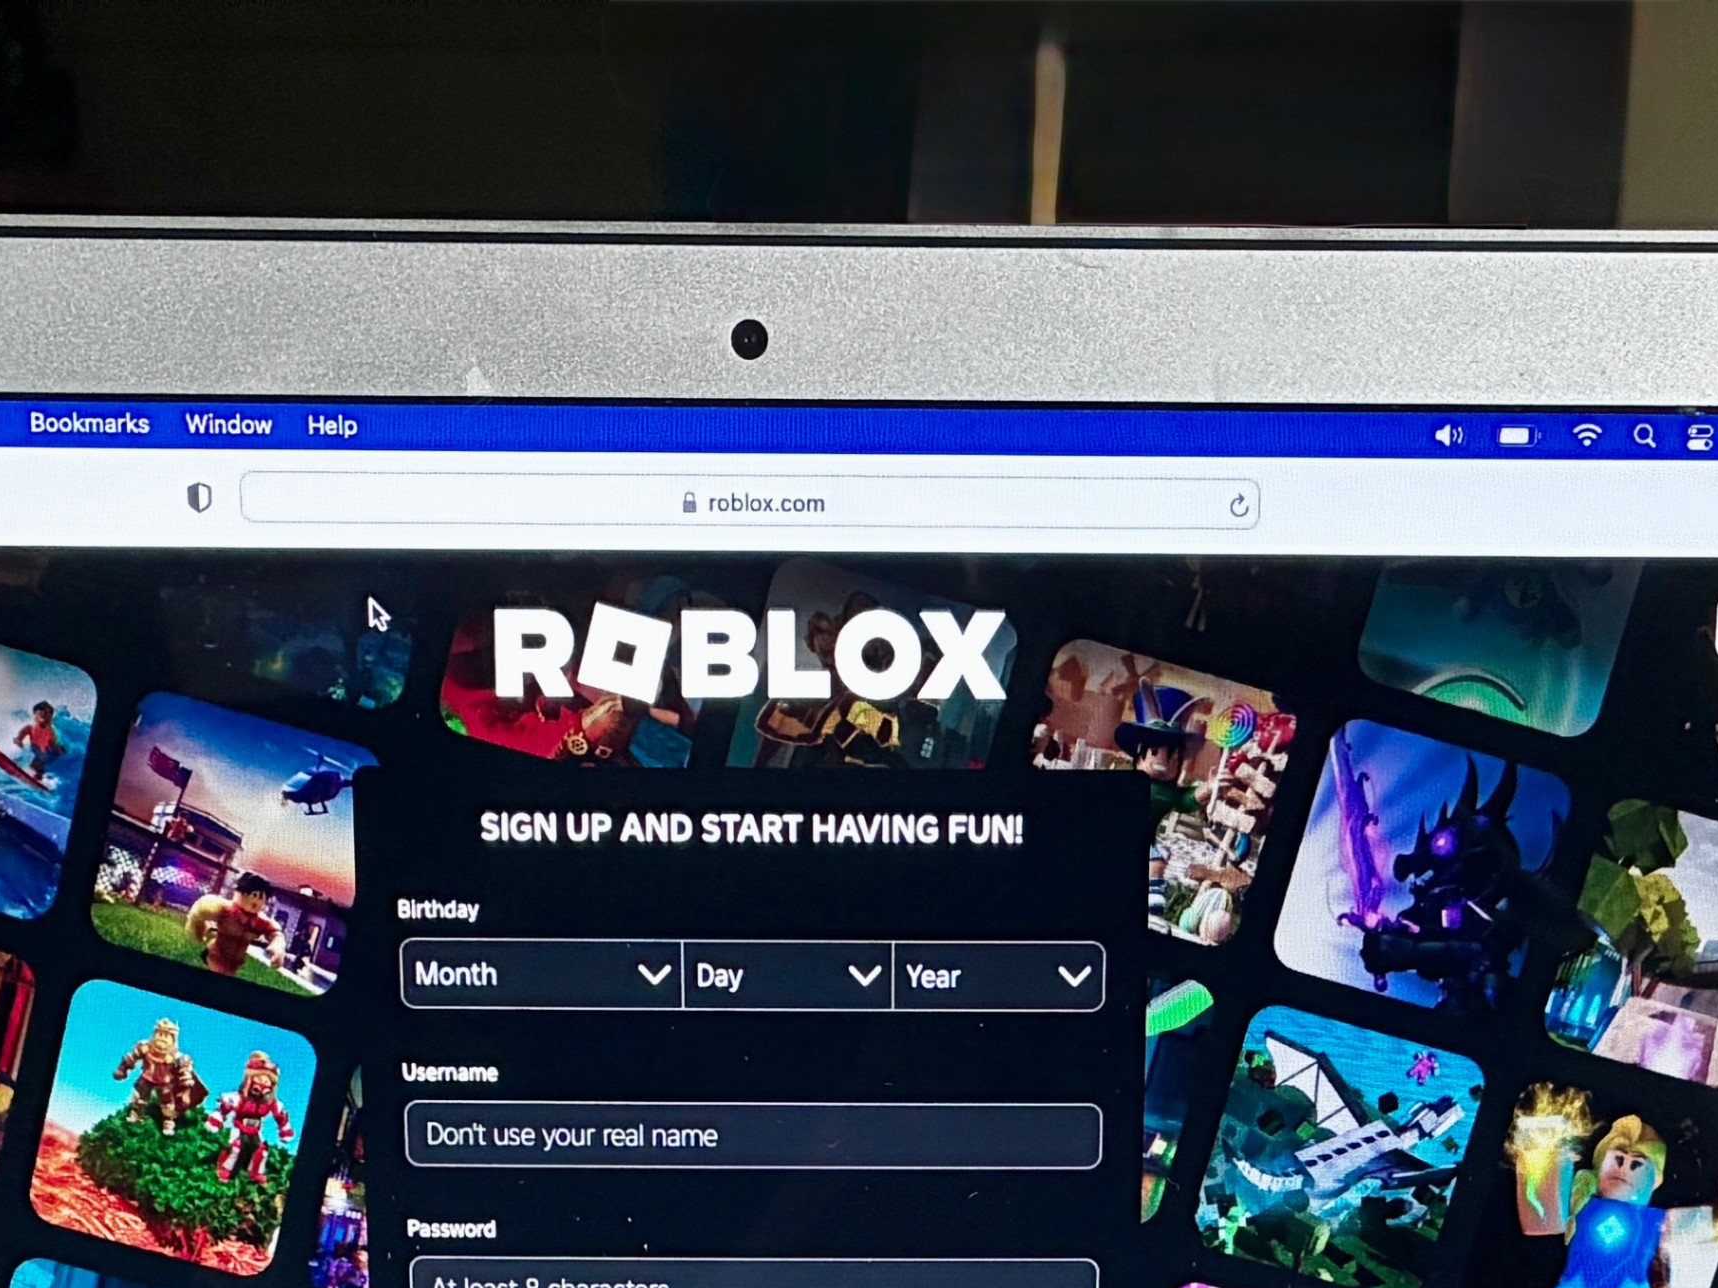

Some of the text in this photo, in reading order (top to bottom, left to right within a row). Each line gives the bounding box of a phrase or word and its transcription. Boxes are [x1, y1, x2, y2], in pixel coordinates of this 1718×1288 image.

[30, 411, 151, 434] Bookmarks
[185, 412, 273, 435] Window
[308, 414, 358, 439] Help
[709, 492, 825, 513] roblox.com
[493, 601, 1007, 704] ROBLOX
[480, 811, 1024, 845] SIGN UP AND START HAVING FUN!
[397, 898, 480, 923] Birthday
[415, 960, 498, 987] Month
[697, 962, 744, 993] Day
[906, 963, 962, 989] Year
[401, 1062, 499, 1083] Username
[426, 1121, 719, 1152] Don't use your real name
[406, 1218, 497, 1239] Password
